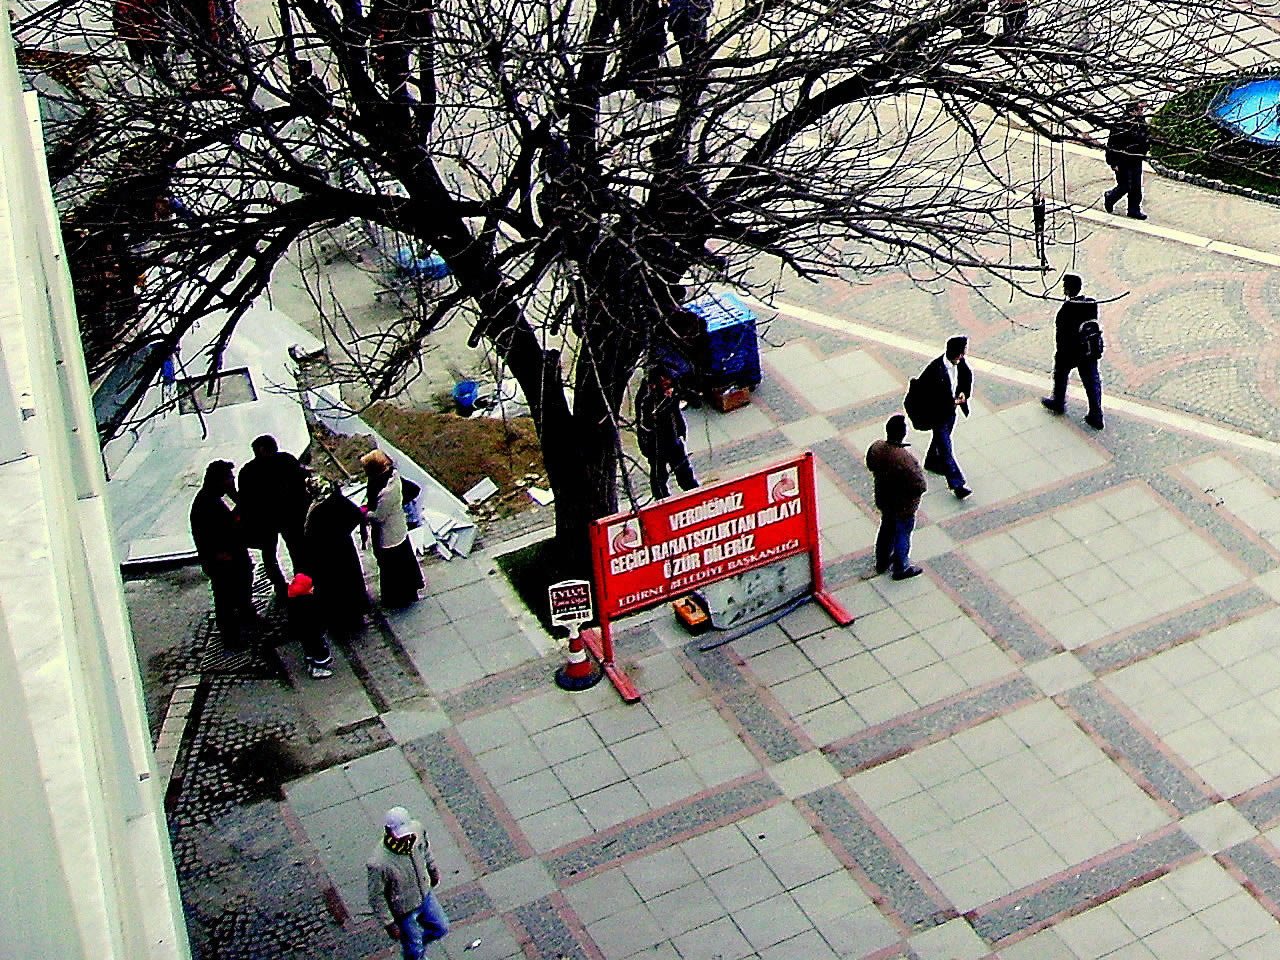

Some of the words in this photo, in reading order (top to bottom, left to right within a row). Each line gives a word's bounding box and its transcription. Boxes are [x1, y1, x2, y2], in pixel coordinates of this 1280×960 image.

[610, 547, 650, 576] GEÇİCİ
[651, 517, 756, 562] RAHATSIZLIKTAN
[757, 497, 801, 527] DOLAYI
[669, 492, 744, 531] VERDİĞİMİZ
[618, 585, 664, 608] EDİRNE
[670, 566, 724, 589] BELEDİYE
[728, 539, 799, 571] BAŞKANLIĞI
[663, 552, 701, 578] ÖZÜR
[703, 535, 756, 566] DİLERİZ
